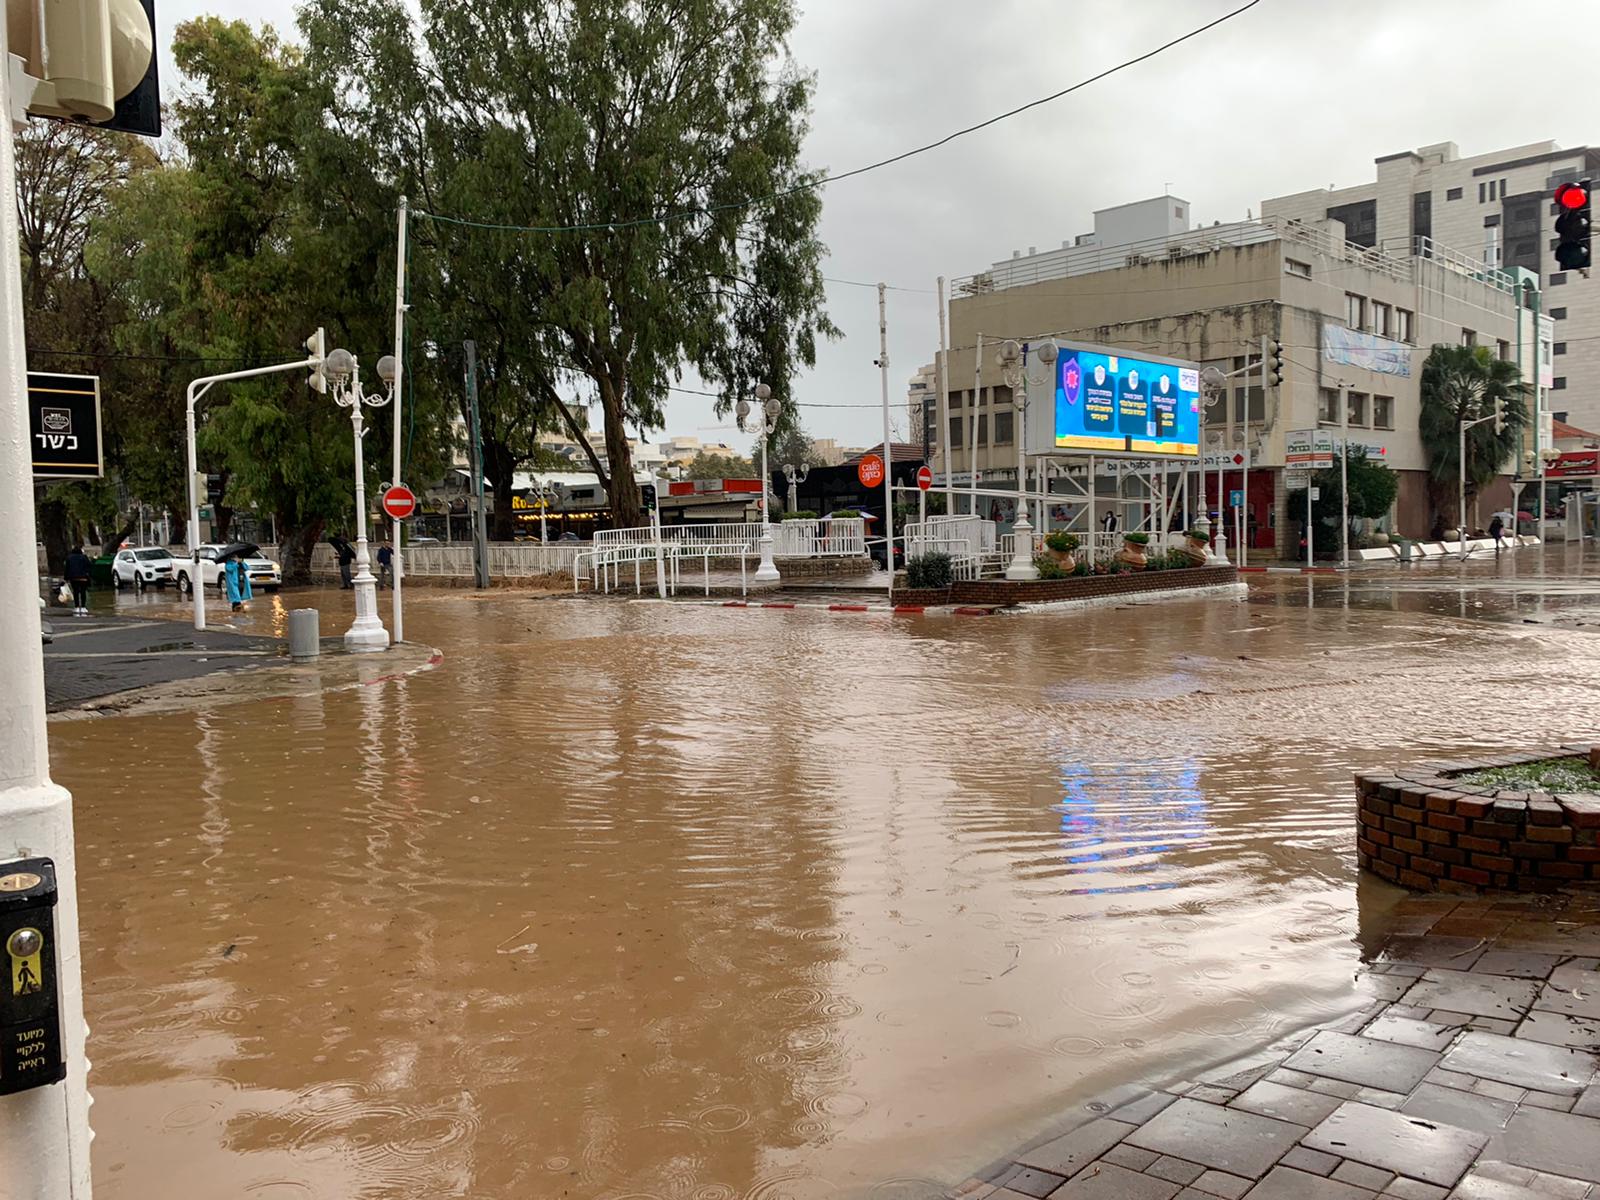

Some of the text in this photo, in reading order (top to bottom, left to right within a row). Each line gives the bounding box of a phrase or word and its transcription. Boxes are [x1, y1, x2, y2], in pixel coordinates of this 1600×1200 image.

[35, 433, 78, 450] כשר
[16, 1028, 44, 1041] מיועד
[16, 1042, 45, 1057] ללקויי
[18, 1057, 45, 1071] ראייה
